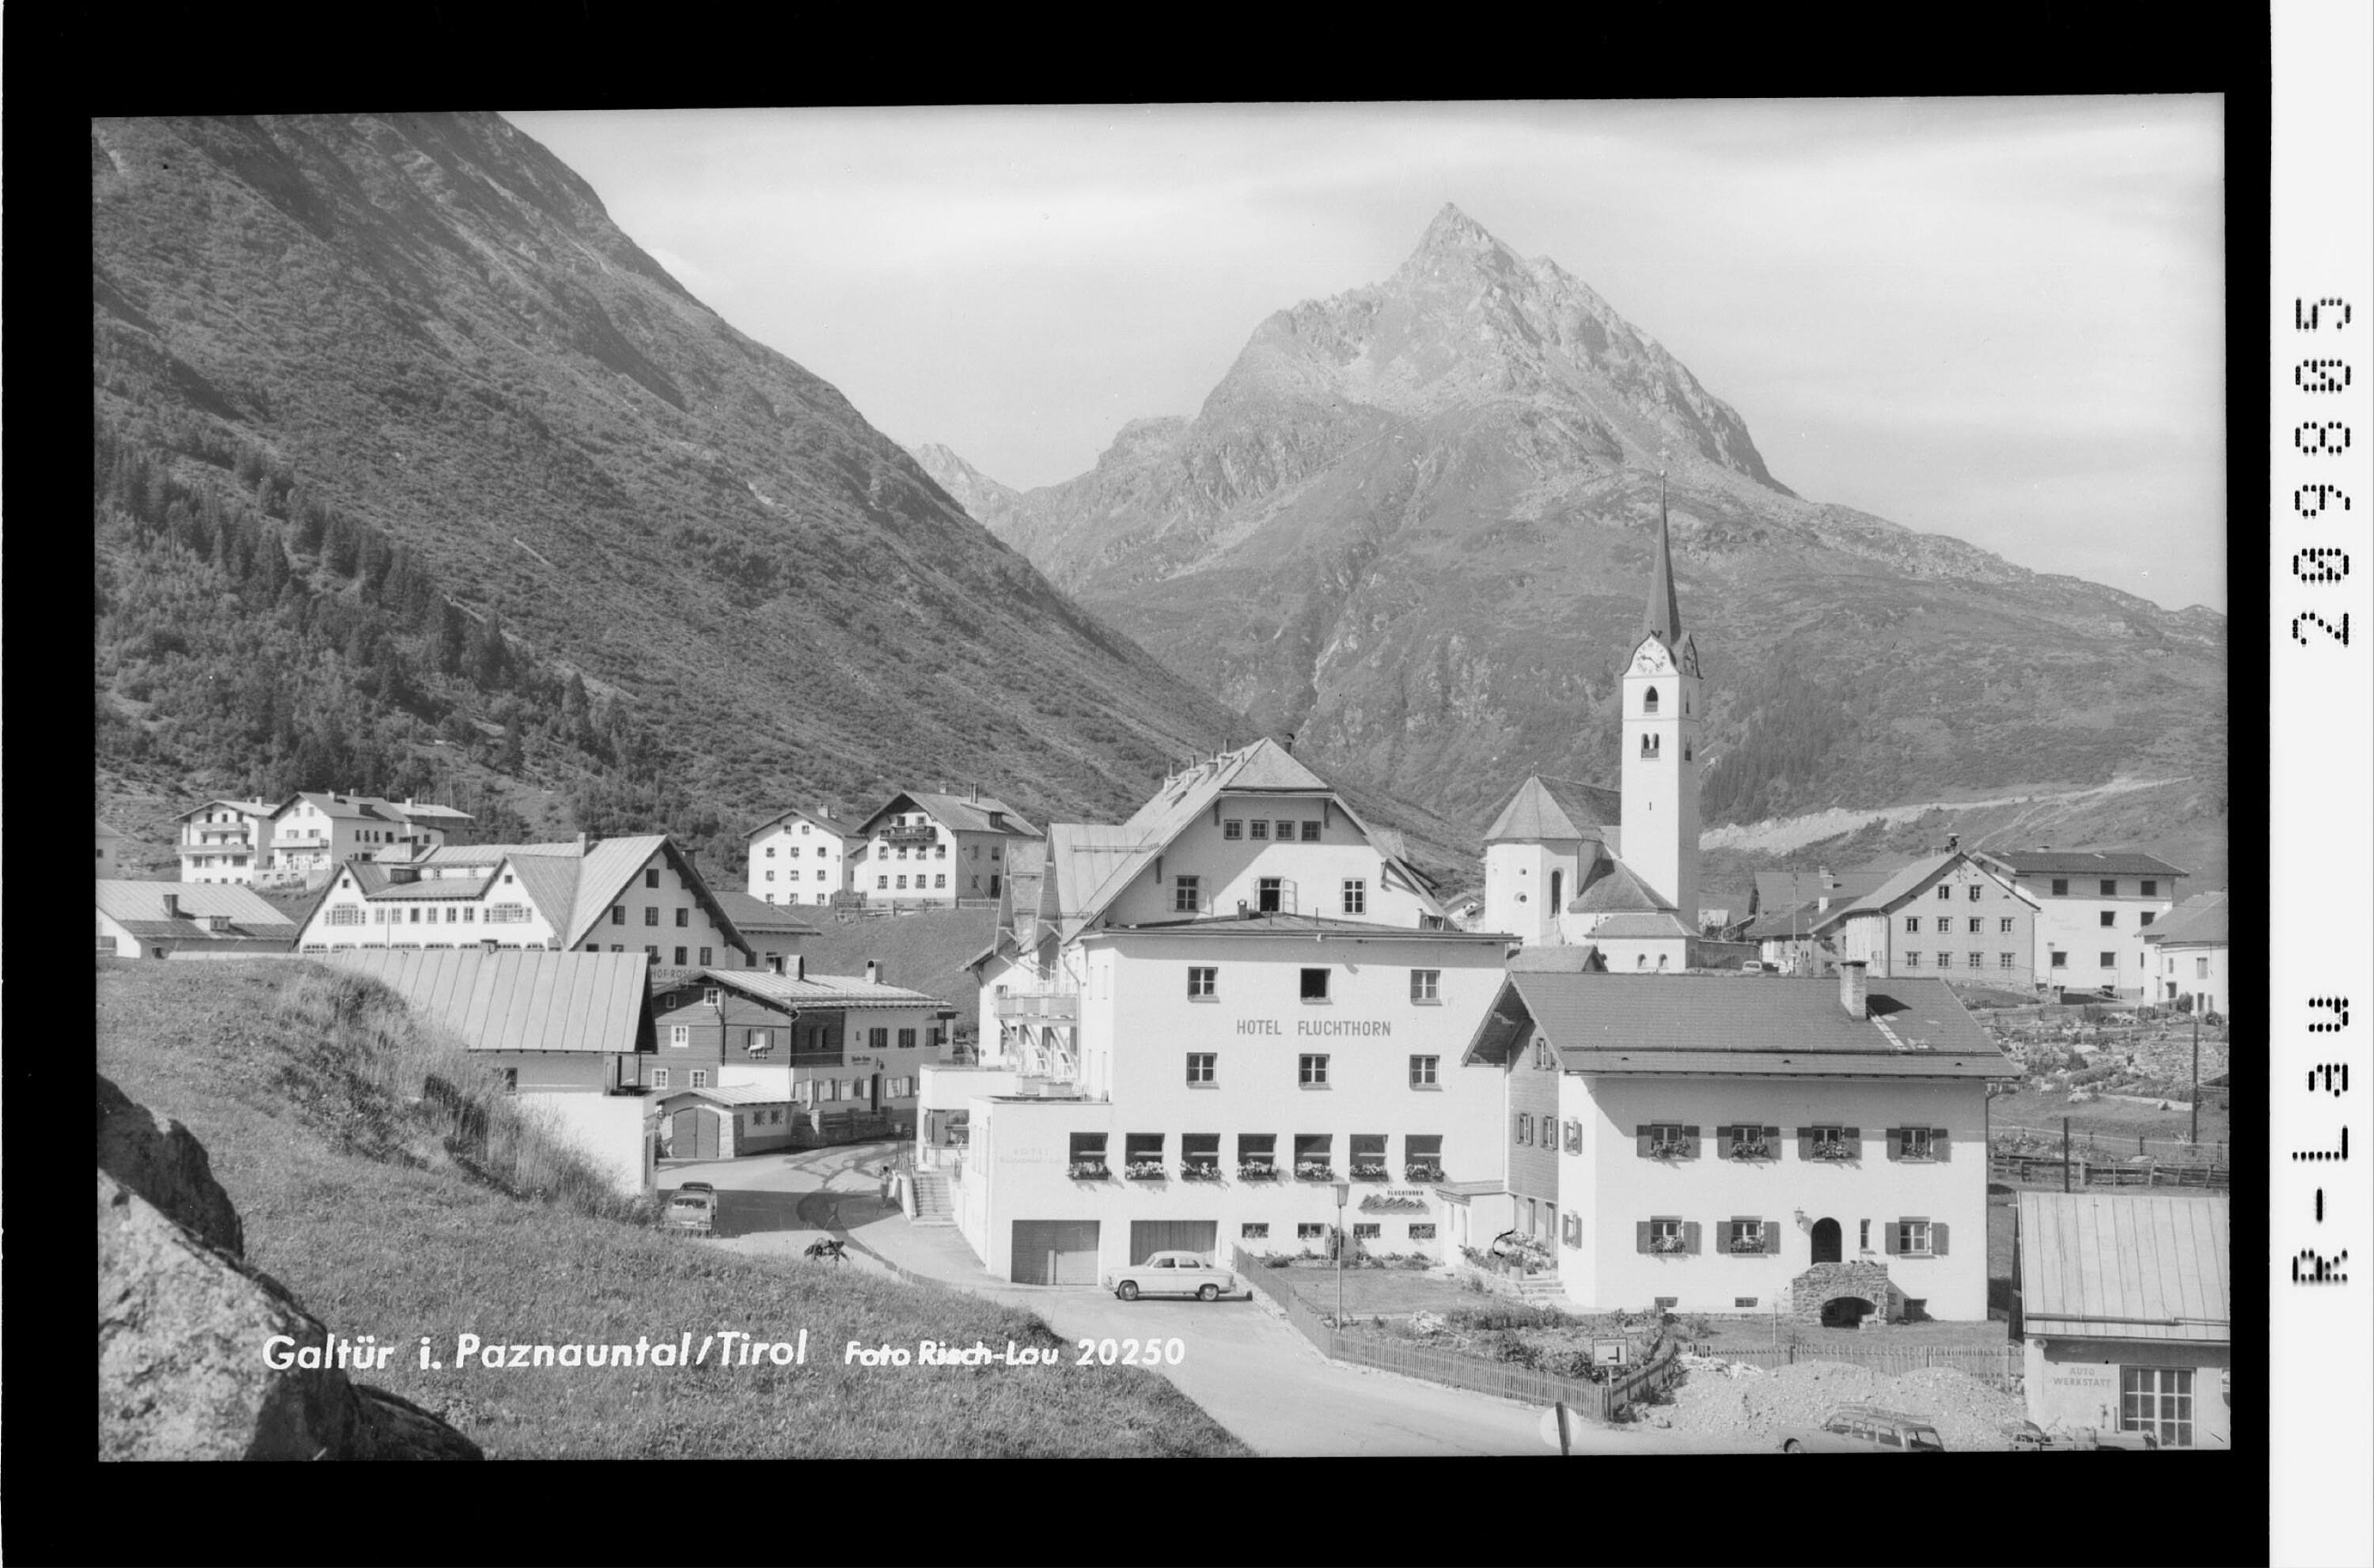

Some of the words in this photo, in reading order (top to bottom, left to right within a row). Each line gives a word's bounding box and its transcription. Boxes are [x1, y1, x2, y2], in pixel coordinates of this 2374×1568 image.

[1236, 1019, 1282, 1036] HOTEL
[1297, 1020, 1391, 1036] FLUCHTHORN
[2069, 1367, 2095, 1377] AUTO
[2053, 1377, 2113, 1388] WERKSTATT
